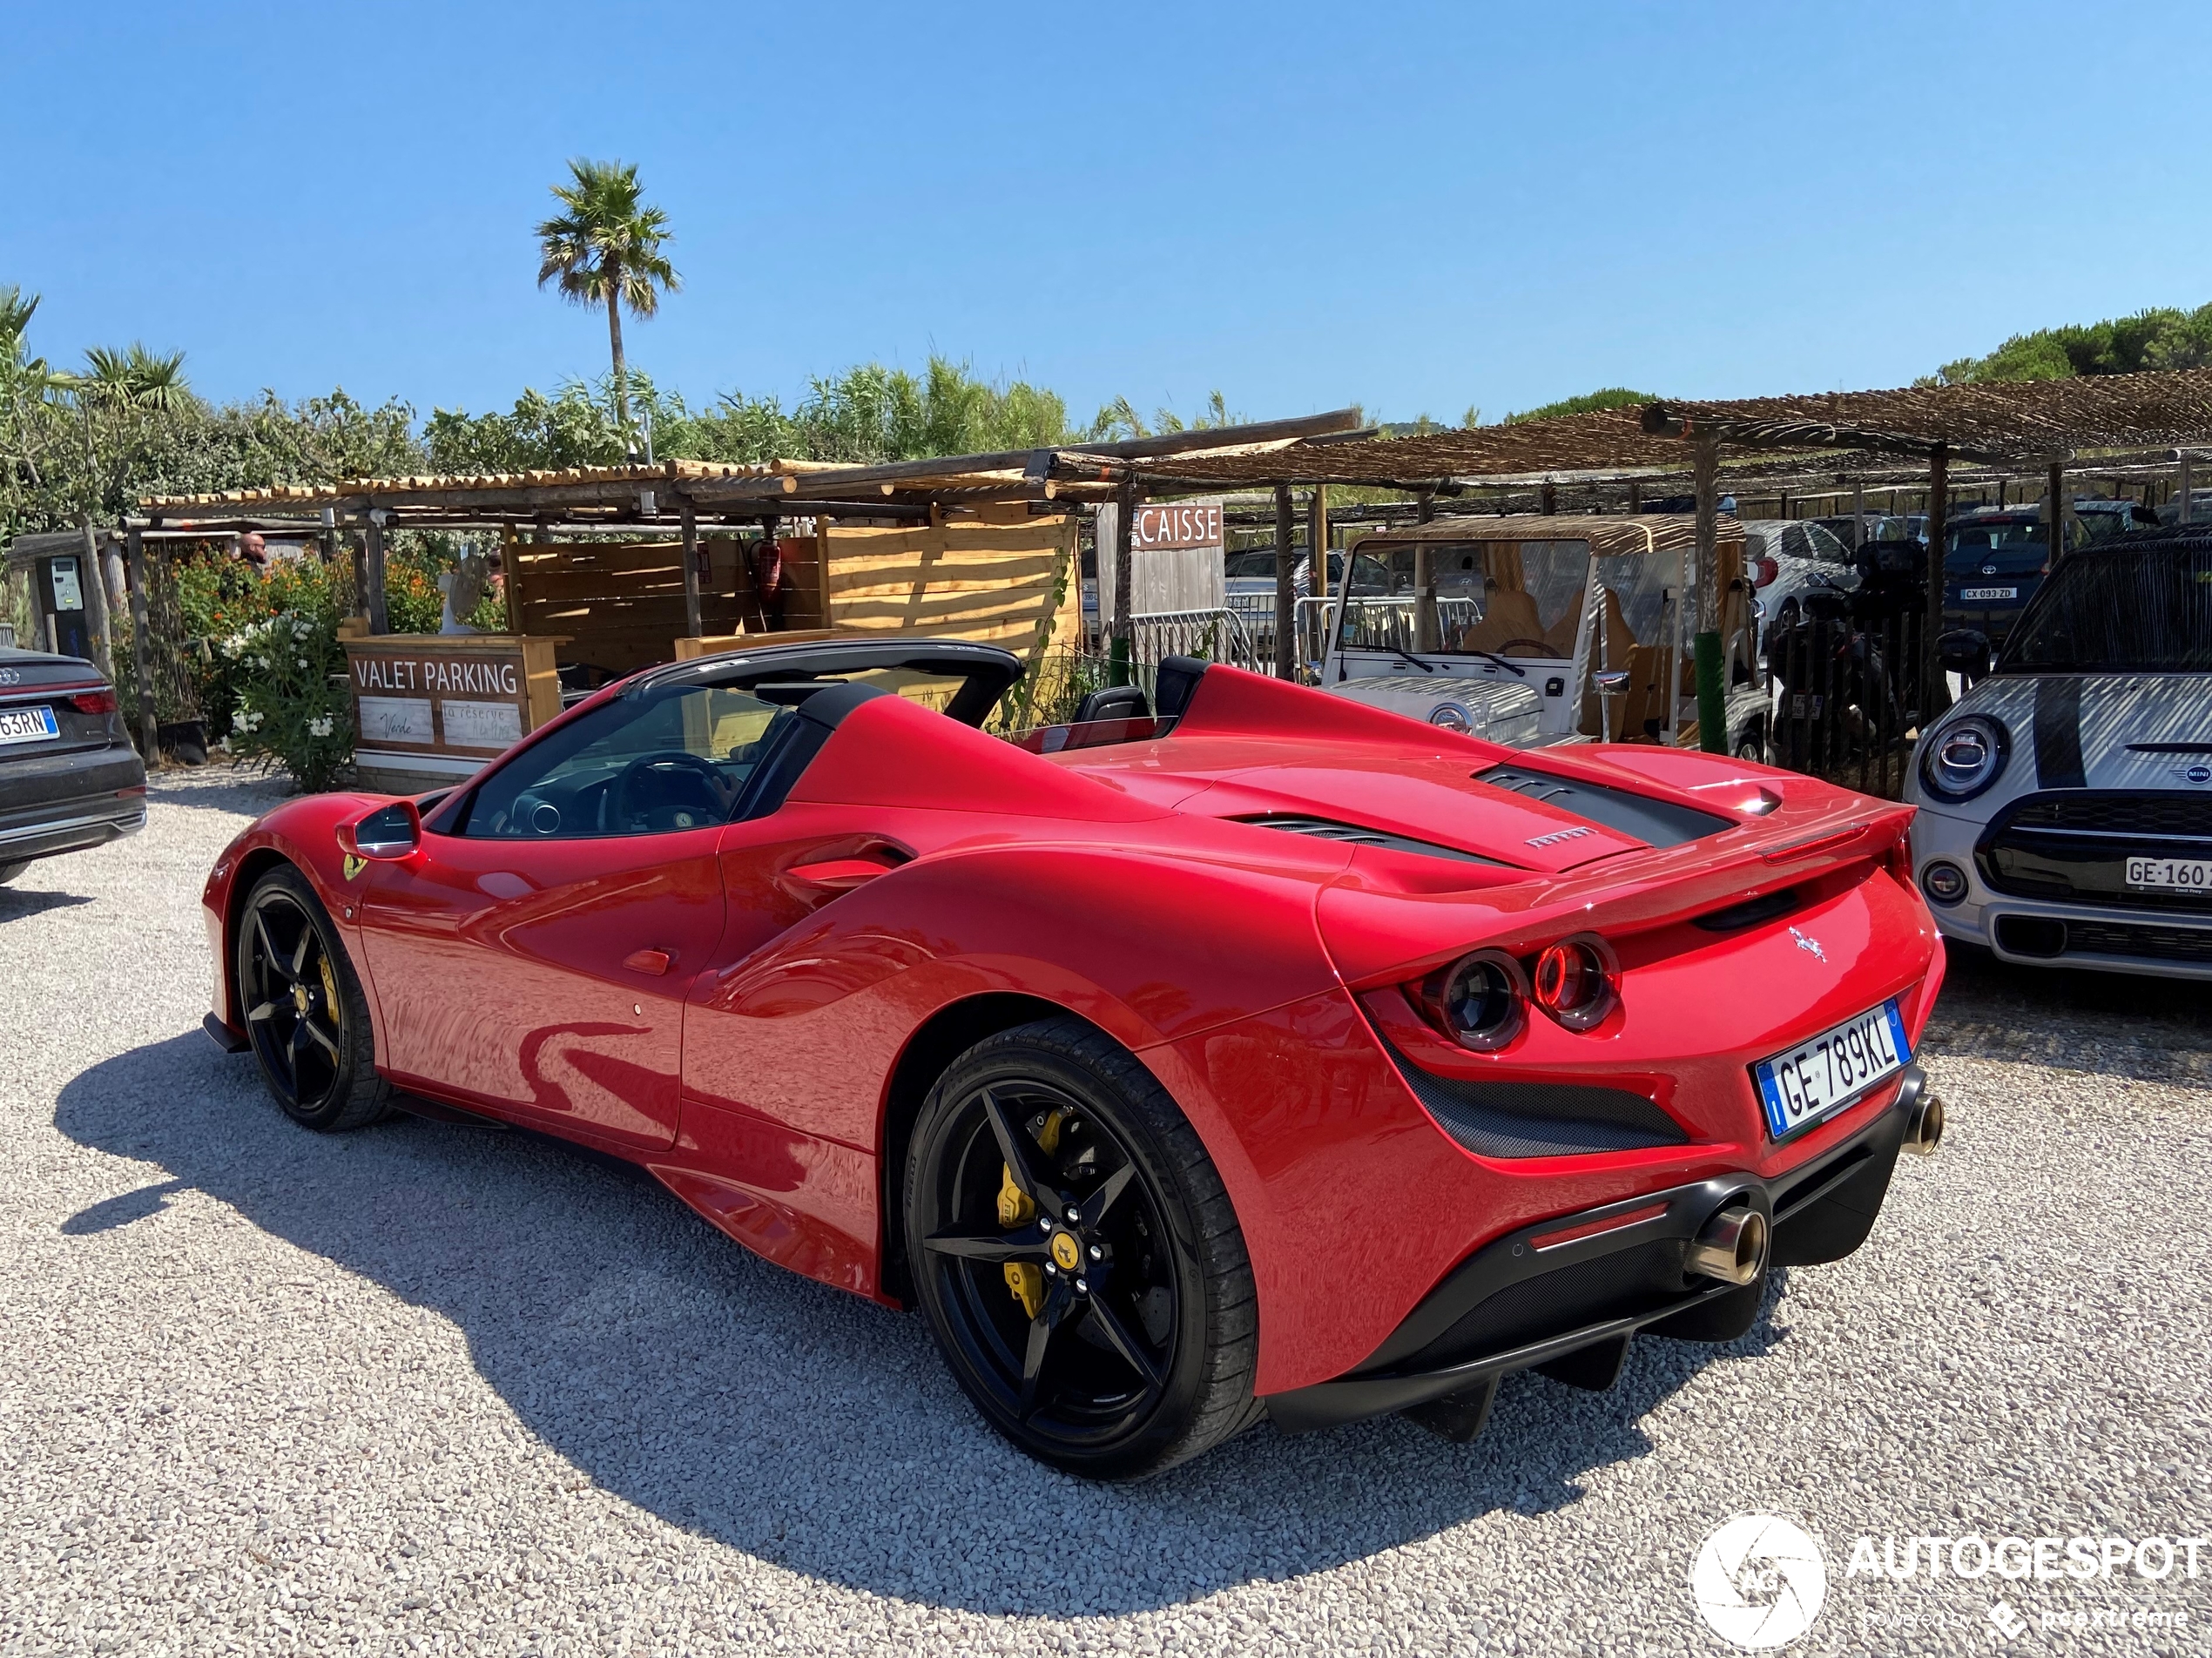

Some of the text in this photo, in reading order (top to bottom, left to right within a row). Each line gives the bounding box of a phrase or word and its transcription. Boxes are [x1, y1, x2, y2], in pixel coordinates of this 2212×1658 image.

[1140, 509, 1218, 543] CAISSE
[1980, 590, 1997, 598] 093
[355, 660, 517, 694] VALET PARKING
[380, 711, 413, 738] Verde
[443, 703, 504, 720] la réserve
[1780, 1014, 1895, 1115] GE 789KL
